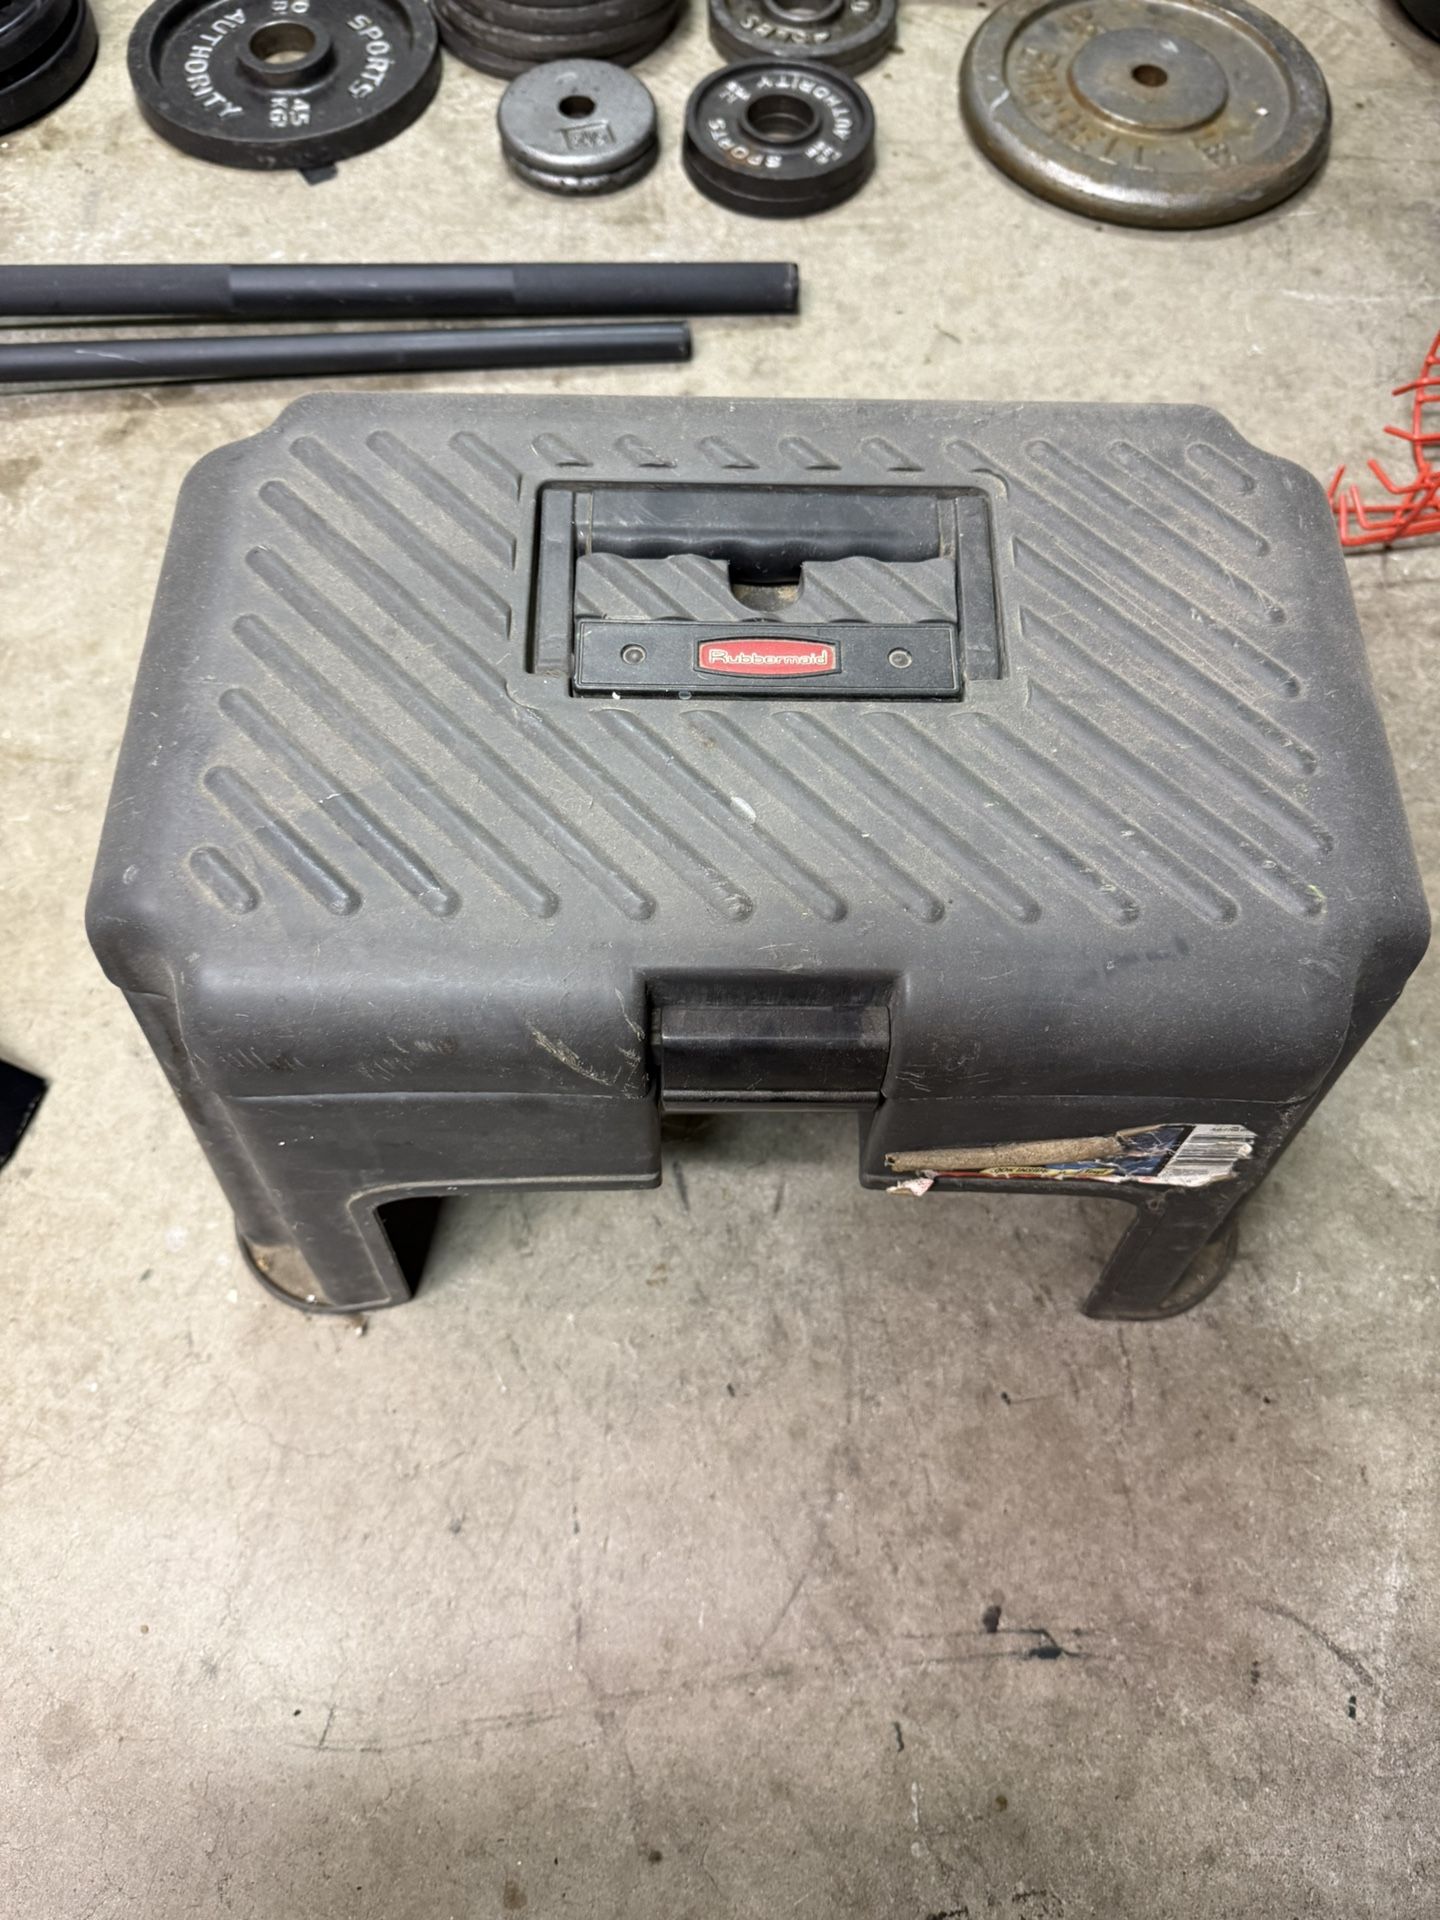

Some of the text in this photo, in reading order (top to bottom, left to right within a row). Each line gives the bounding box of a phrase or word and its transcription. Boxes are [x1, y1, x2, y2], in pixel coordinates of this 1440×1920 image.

[184, 8, 247, 121] AUTHORITY
[347, 13, 395, 100] SPORTS
[756, 74, 853, 141] AUTHORITY
[708, 118, 783, 169] SPORTS
[708, 649, 828, 665] Rubbermaid
